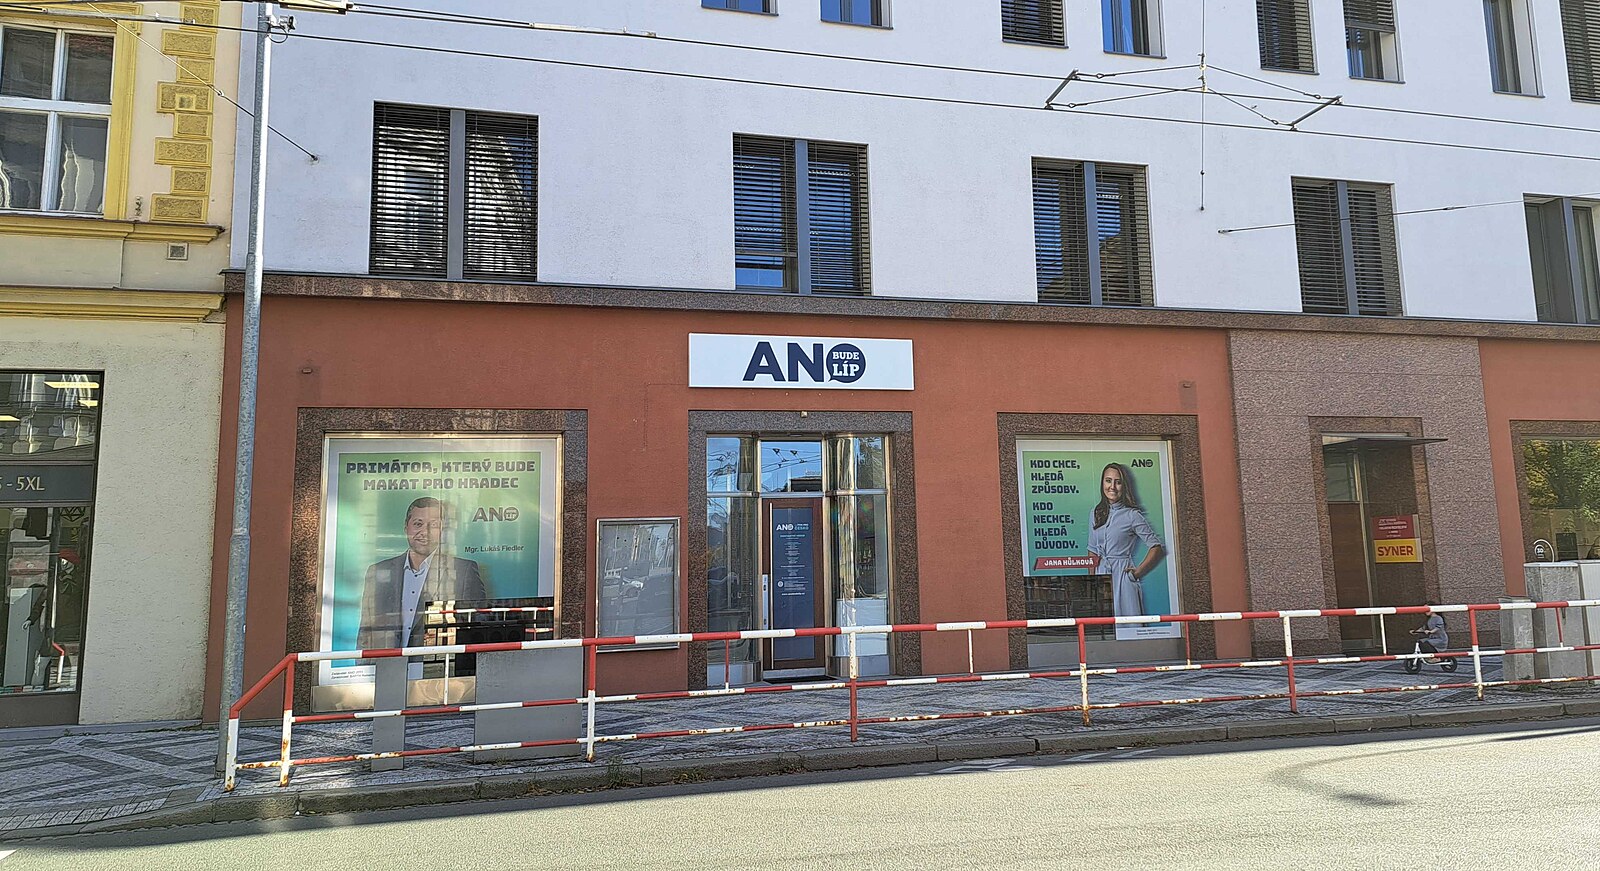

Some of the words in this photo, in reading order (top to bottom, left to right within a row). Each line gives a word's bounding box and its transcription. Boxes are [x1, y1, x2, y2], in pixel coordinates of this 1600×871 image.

[832, 351, 860, 360] BUDE
[832, 360, 860, 377] LÍP
[346, 459, 438, 474] PRIMÁTOR,
[441, 458, 492, 473] KTERÝ
[495, 460, 536, 473] BUDE
[1030, 459, 1051, 469] KDO
[1052, 459, 1080, 470] CHCE,
[1030, 470, 1064, 482] HLEDÁ
[16, 476, 46, 491] 5XL
[363, 478, 420, 491] MAKAT
[422, 477, 454, 490] PRO
[457, 477, 519, 490] HRADEC
[1031, 481, 1080, 494] ZPŮSOBY.
[1032, 501, 1053, 511] KDO
[1033, 514, 1075, 525] NECHCE,
[1034, 525, 1068, 537] HLEDÁ
[464, 546, 480, 554] Mgr.
[480, 544, 500, 552] Lukáš
[501, 543, 525, 552] Fiedler
[1035, 537, 1079, 550] DŮVODY.
[1377, 545, 1414, 557] SYNER
[1044, 559, 1062, 567] JANA
[1062, 557, 1094, 567] HŮLKOVÁ
